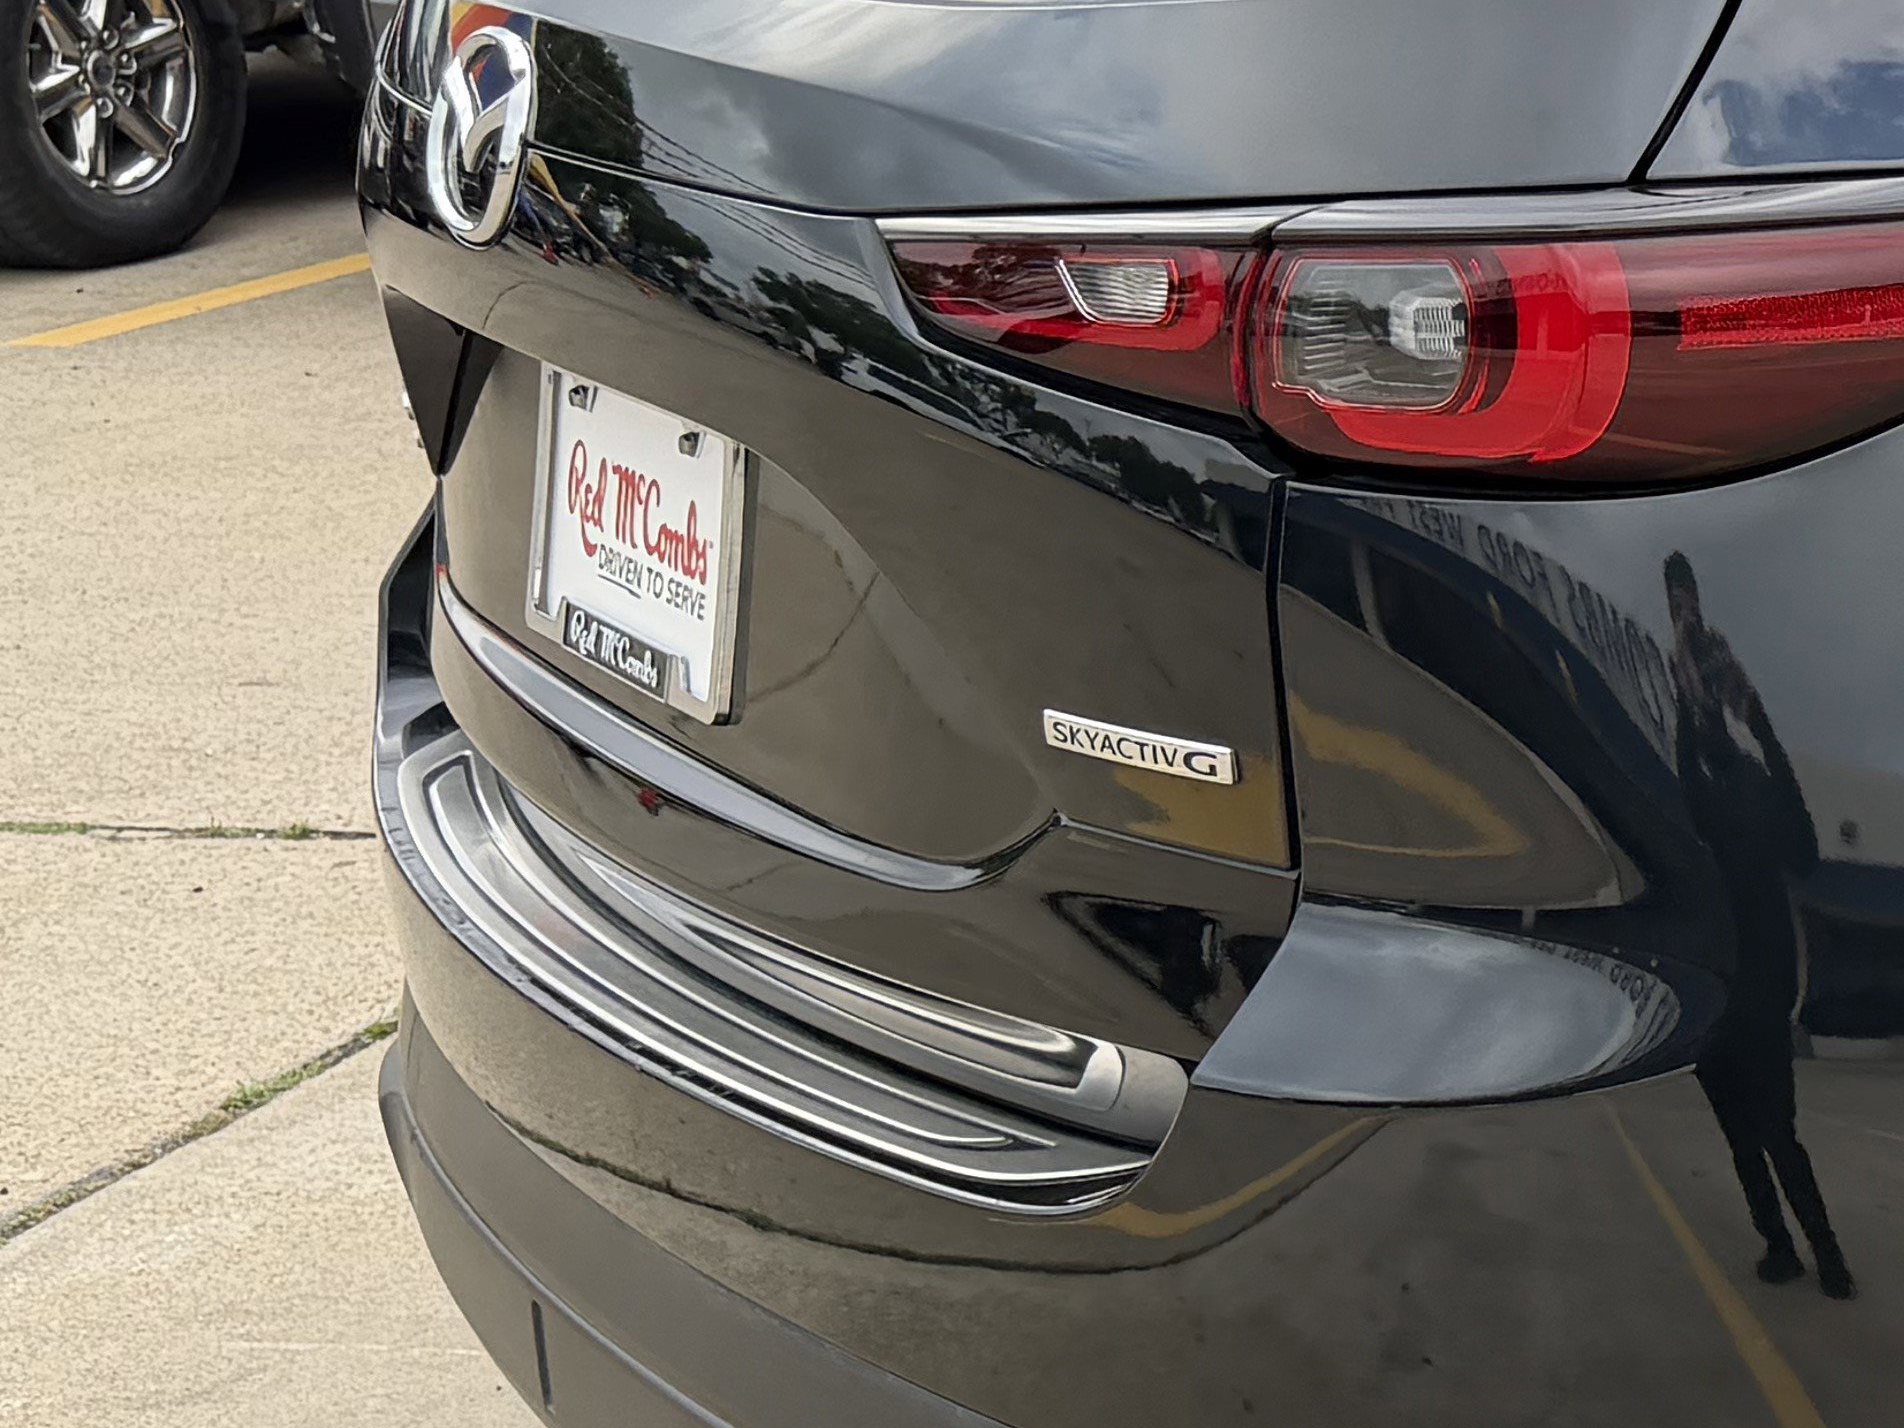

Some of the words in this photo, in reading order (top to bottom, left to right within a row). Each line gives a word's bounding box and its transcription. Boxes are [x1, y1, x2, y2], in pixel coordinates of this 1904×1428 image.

[567, 439, 608, 558] Red
[611, 464, 708, 586] McCombs
[598, 543, 644, 590] DRIVEN
[646, 566, 664, 599] TO
[665, 577, 706, 621] SERVE
[570, 609, 599, 656] Red
[1052, 720, 1178, 768] SKYACTIV
